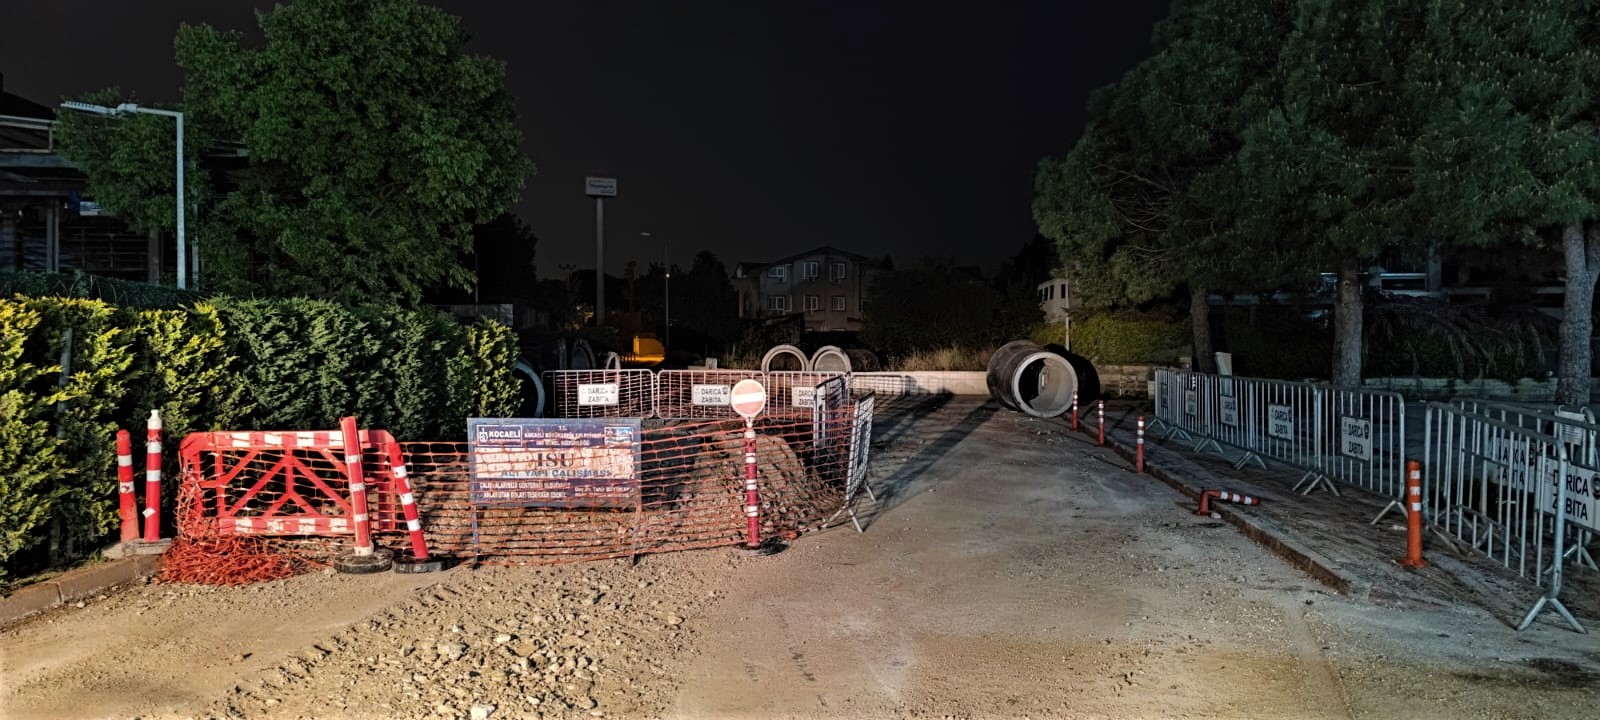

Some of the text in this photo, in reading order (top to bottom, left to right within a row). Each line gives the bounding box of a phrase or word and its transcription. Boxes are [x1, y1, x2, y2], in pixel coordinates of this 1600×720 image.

[1348, 422, 1364, 439] DARICA
[1348, 440, 1364, 456] ZABITA
[1553, 469, 1589, 497] DRICA
[1552, 493, 1588, 521] ZBITA
